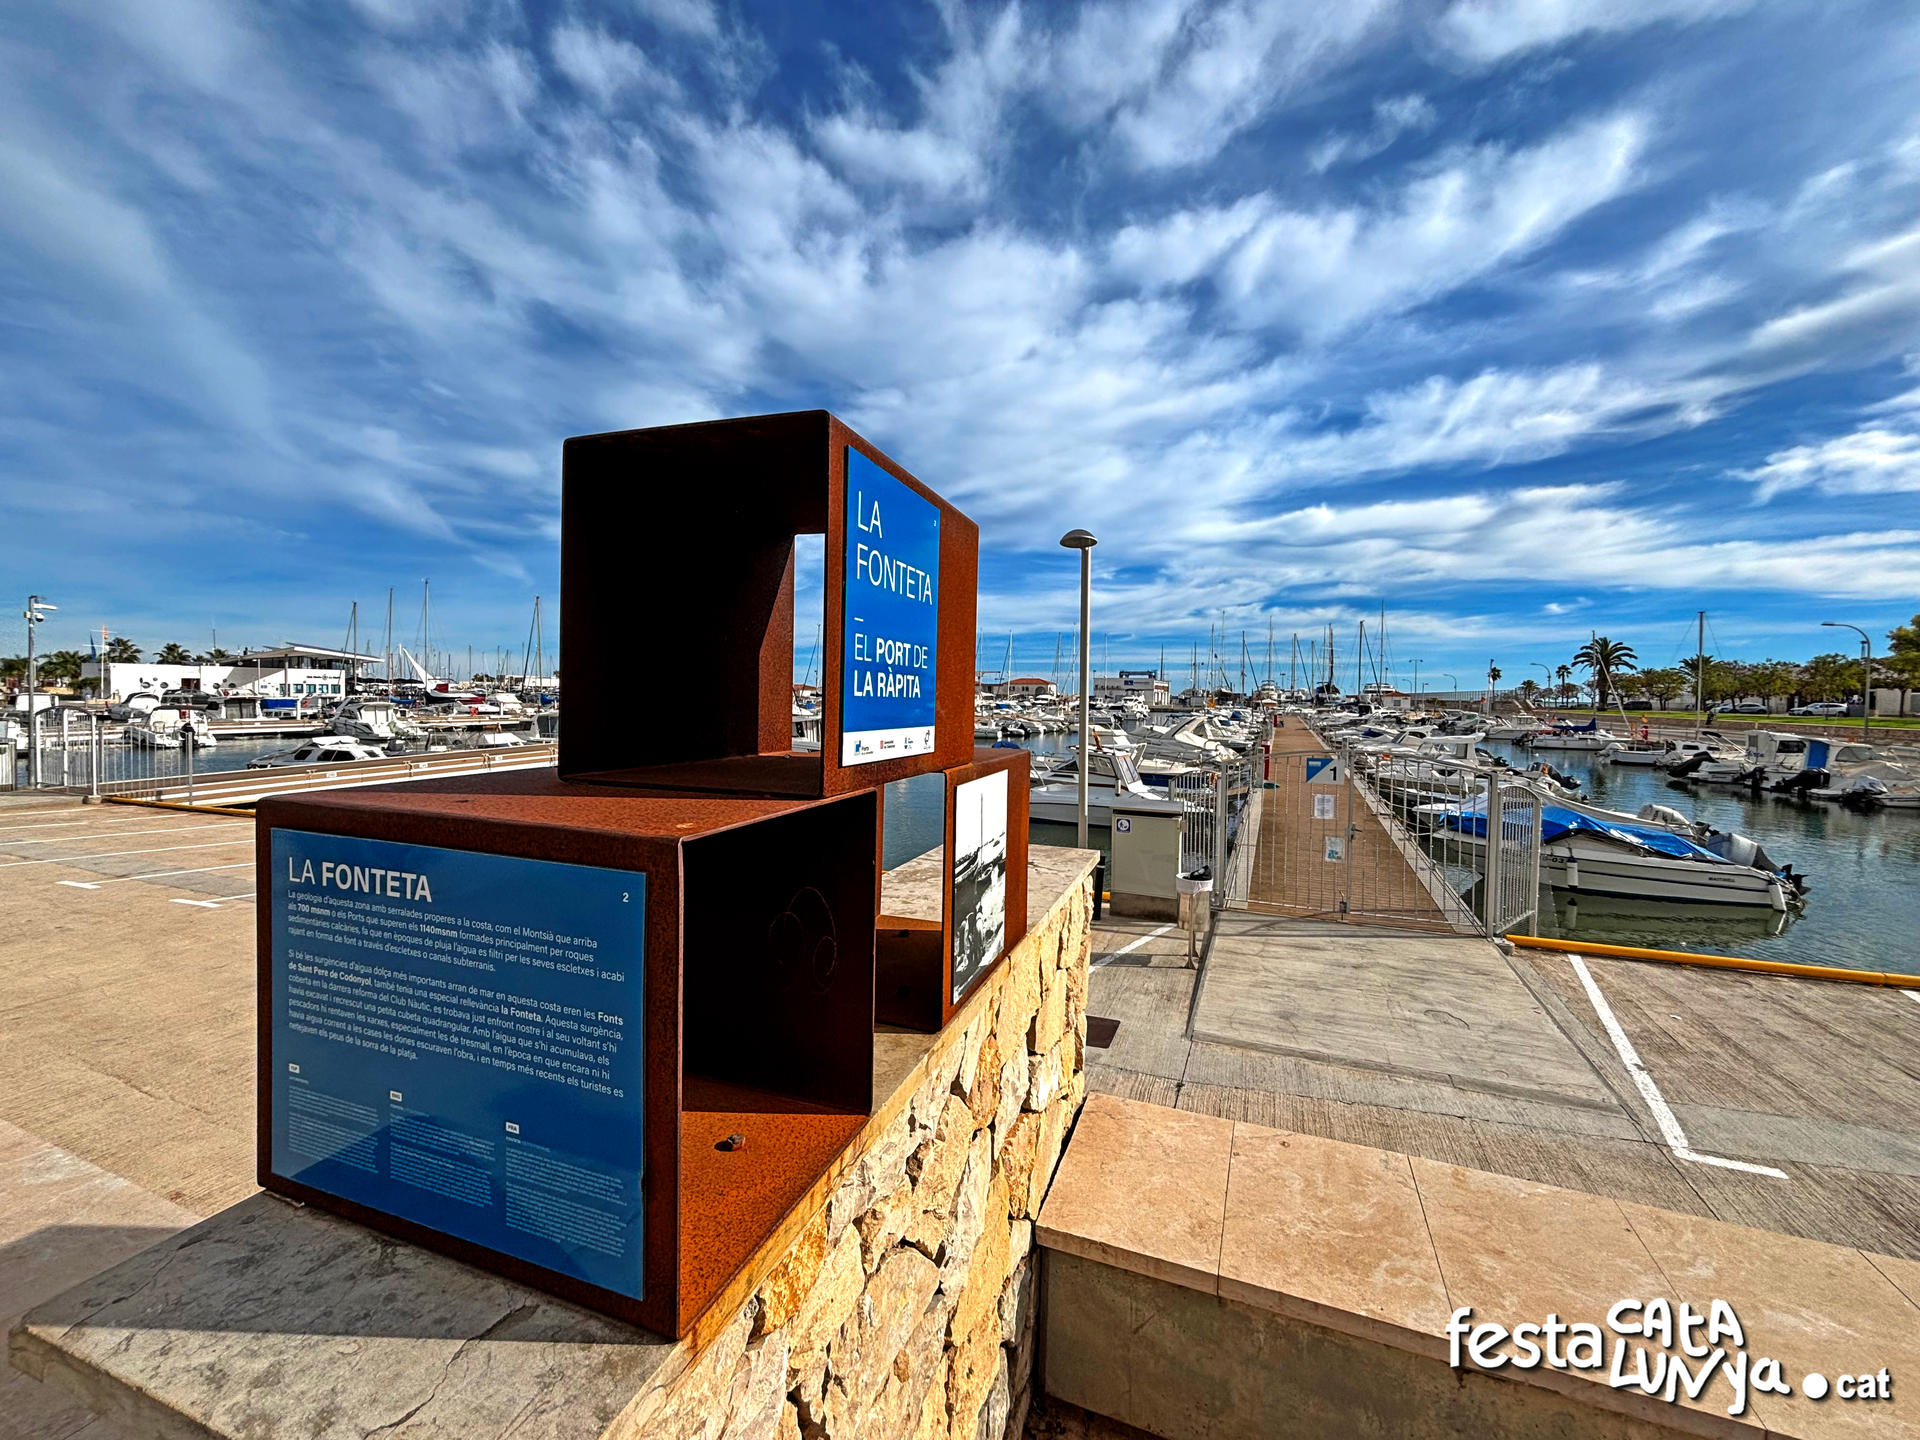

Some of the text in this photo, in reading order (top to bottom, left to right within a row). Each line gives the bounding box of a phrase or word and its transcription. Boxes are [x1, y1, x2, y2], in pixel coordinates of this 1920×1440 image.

[857, 491, 882, 538] LA
[857, 543, 932, 605] FONTETA
[855, 633, 928, 669] EL PORT DE
[854, 667, 920, 698] LA RÀPITA
[1330, 766, 1337, 781] 1
[288, 857, 432, 902] LA FONTETA
[622, 892, 629, 903] 2
[555, 935, 571, 946] que
[573, 935, 597, 948] arriba
[565, 950, 593, 963] roques
[556, 961, 594, 976] escletxes
[601, 969, 624, 982] acabi
[545, 1014, 578, 1032] Aquesta
[563, 1006, 581, 1016] eren
[583, 1008, 595, 1019] les
[597, 1011, 623, 1025] Fonts
[601, 1069, 609, 1080] hi
[613, 1088, 623, 1098] es
